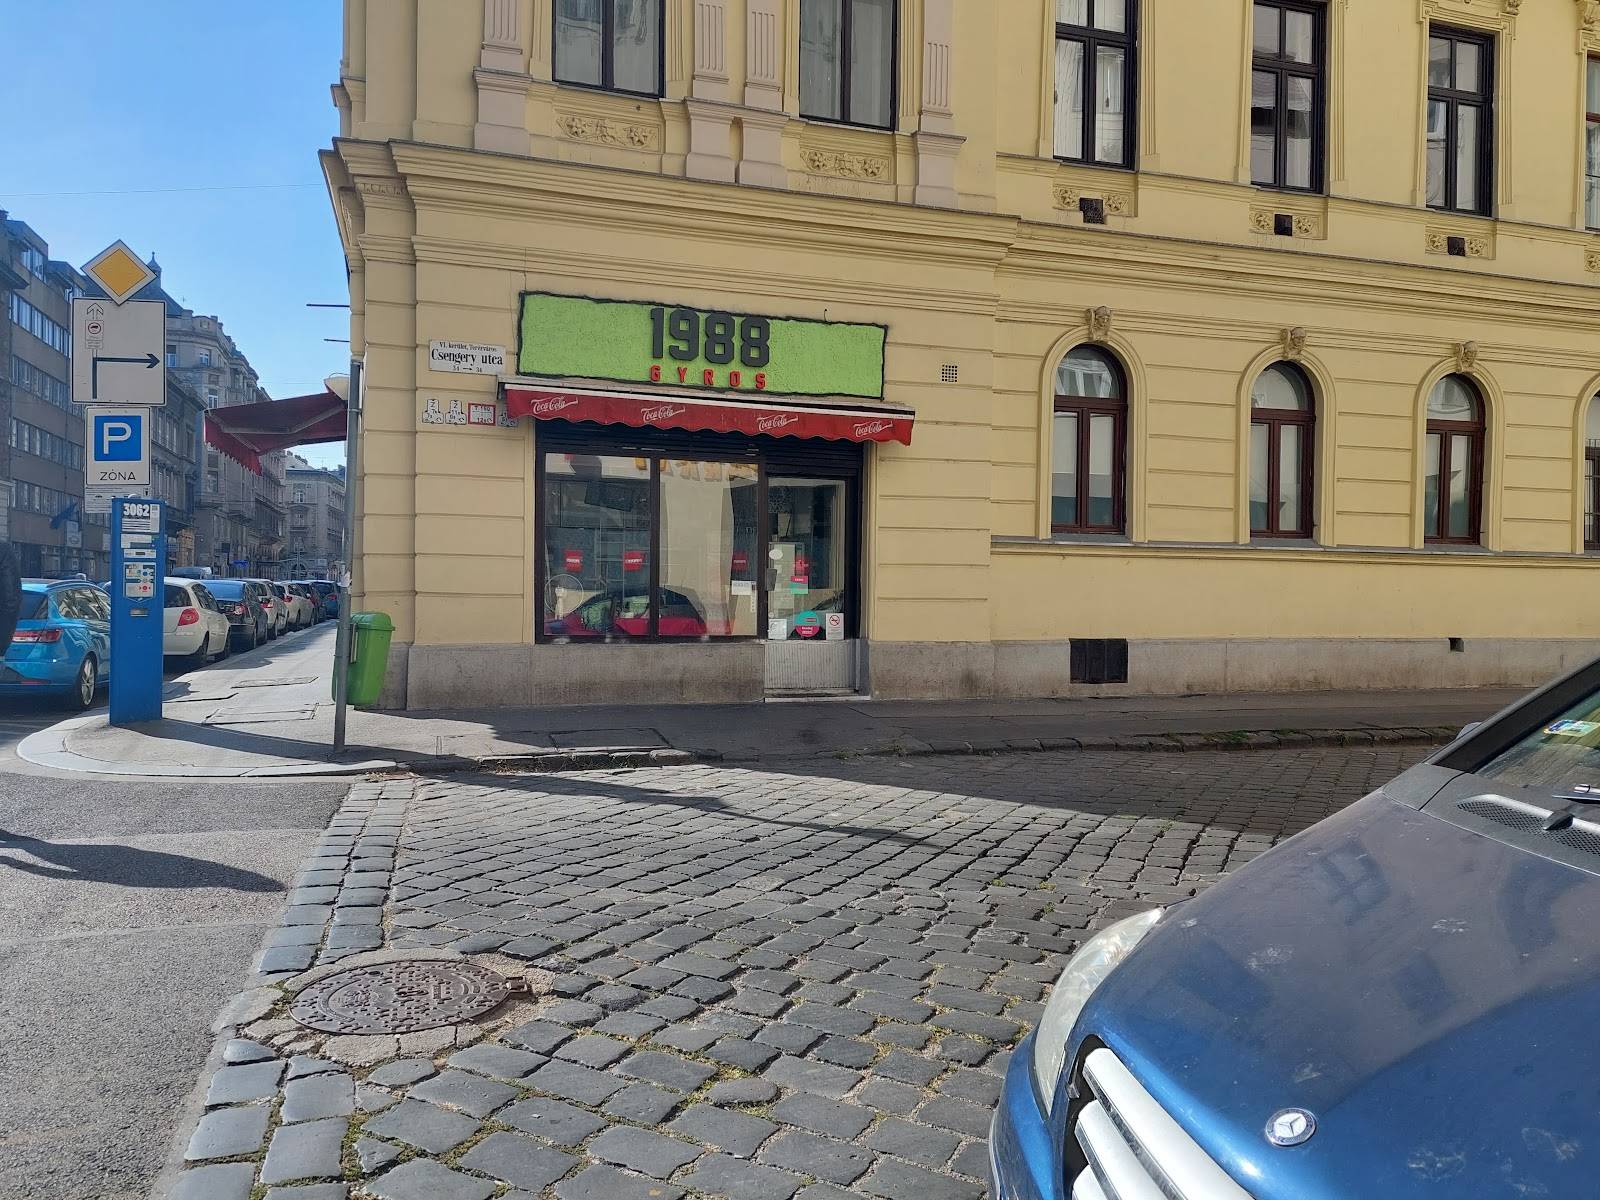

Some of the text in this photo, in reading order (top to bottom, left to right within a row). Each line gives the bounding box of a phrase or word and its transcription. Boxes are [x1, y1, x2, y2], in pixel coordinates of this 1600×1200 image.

[650, 307, 771, 368] 1988
[431, 348, 503, 366] Csengery utca
[650, 364, 766, 390] GYROS
[103, 422, 132, 455] P
[100, 468, 137, 482] ZÓNA
[123, 503, 150, 518] 3062
